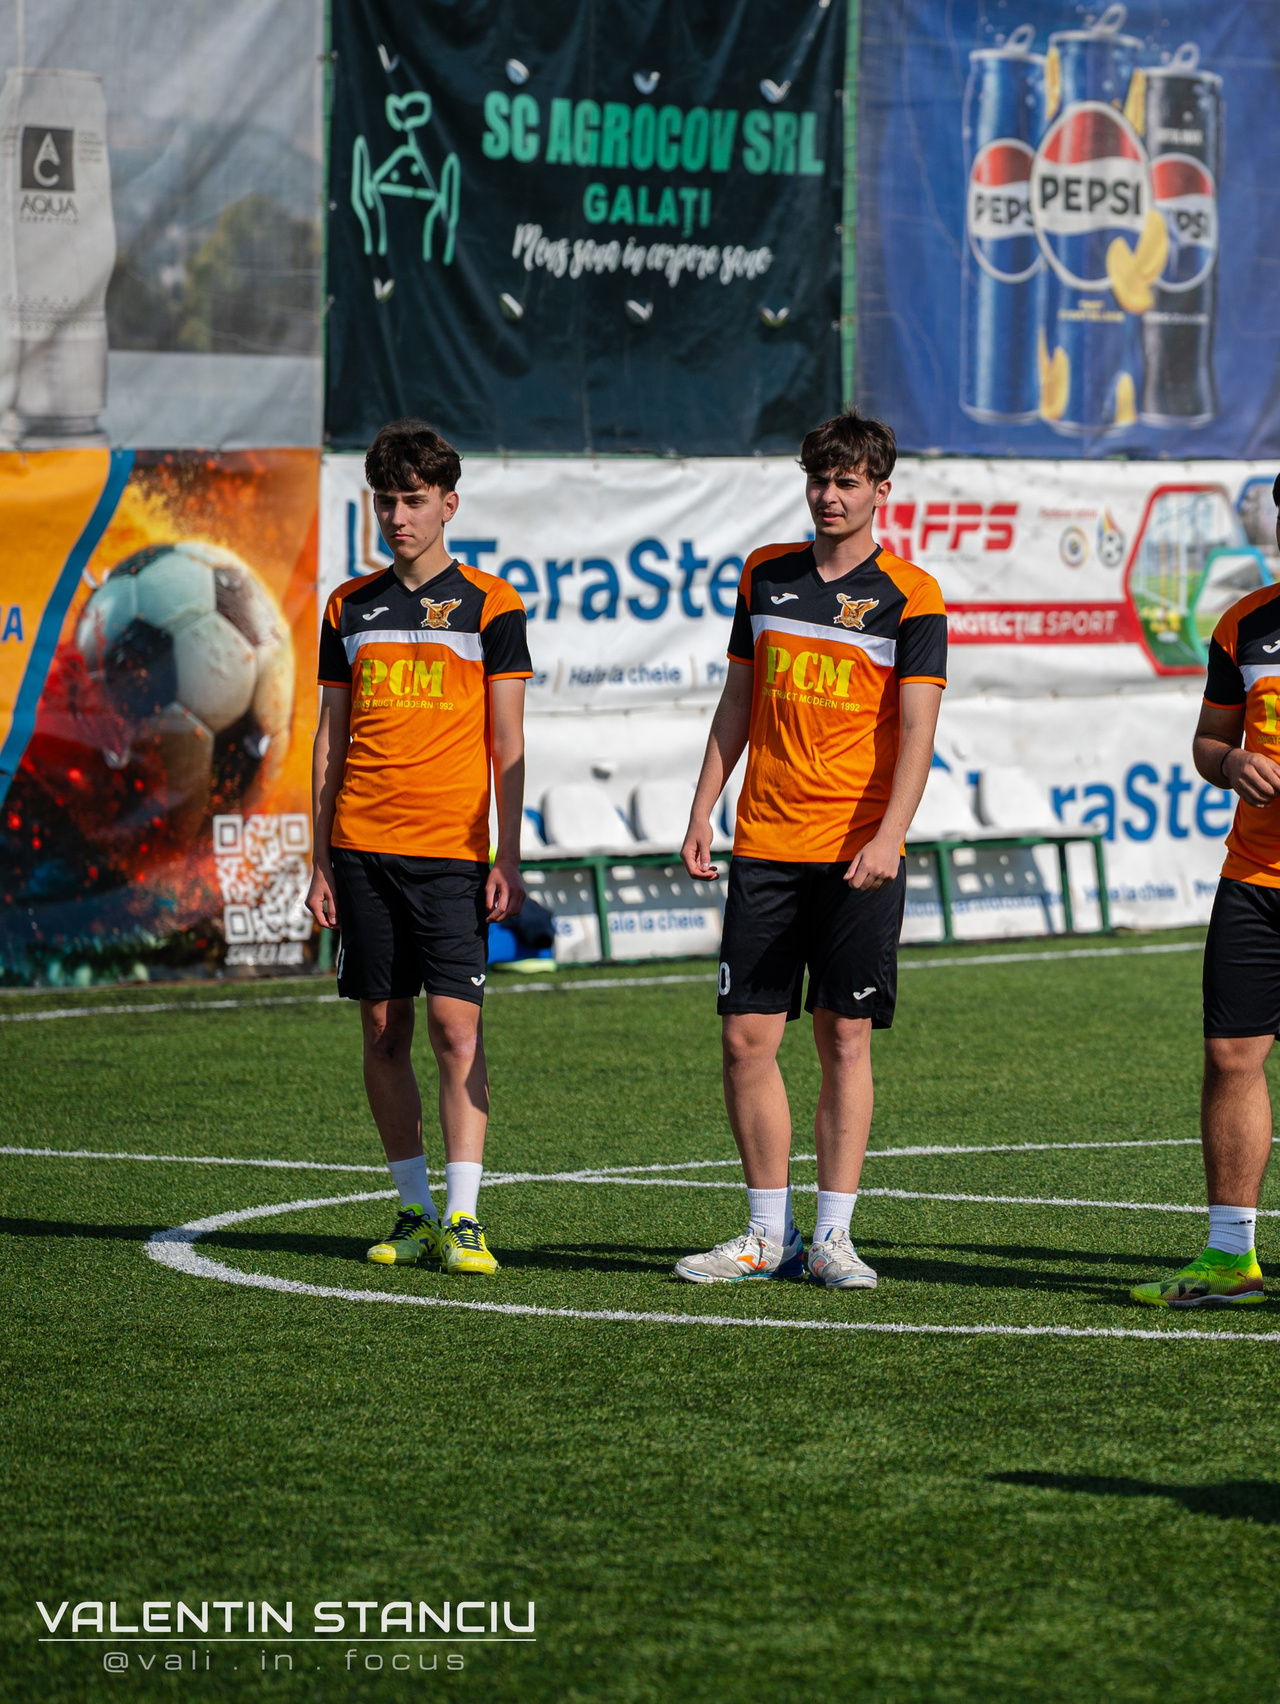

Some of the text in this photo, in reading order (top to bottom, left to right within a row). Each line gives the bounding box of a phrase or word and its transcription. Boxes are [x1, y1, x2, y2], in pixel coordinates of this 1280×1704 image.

[482, 90, 825, 176] SC AGROCOV SRL
[974, 194, 1036, 228] PEPS
[1039, 174, 1142, 216] PEPSI
[1169, 207, 1212, 241] PSI
[449, 537, 742, 623] TeraSte
[947, 609, 1120, 642] ROTECȚIE SPORT
[359, 658, 447, 698] PCM
[765, 645, 857, 698] PCM
[353, 699, 394, 710] CONSRUCT
[436, 701, 454, 711] 1992
[799, 694, 838, 709] MODERN
[840, 702, 861, 712] 1992
[1050, 761, 1232, 843] raSte
[610, 914, 636, 934] ale
